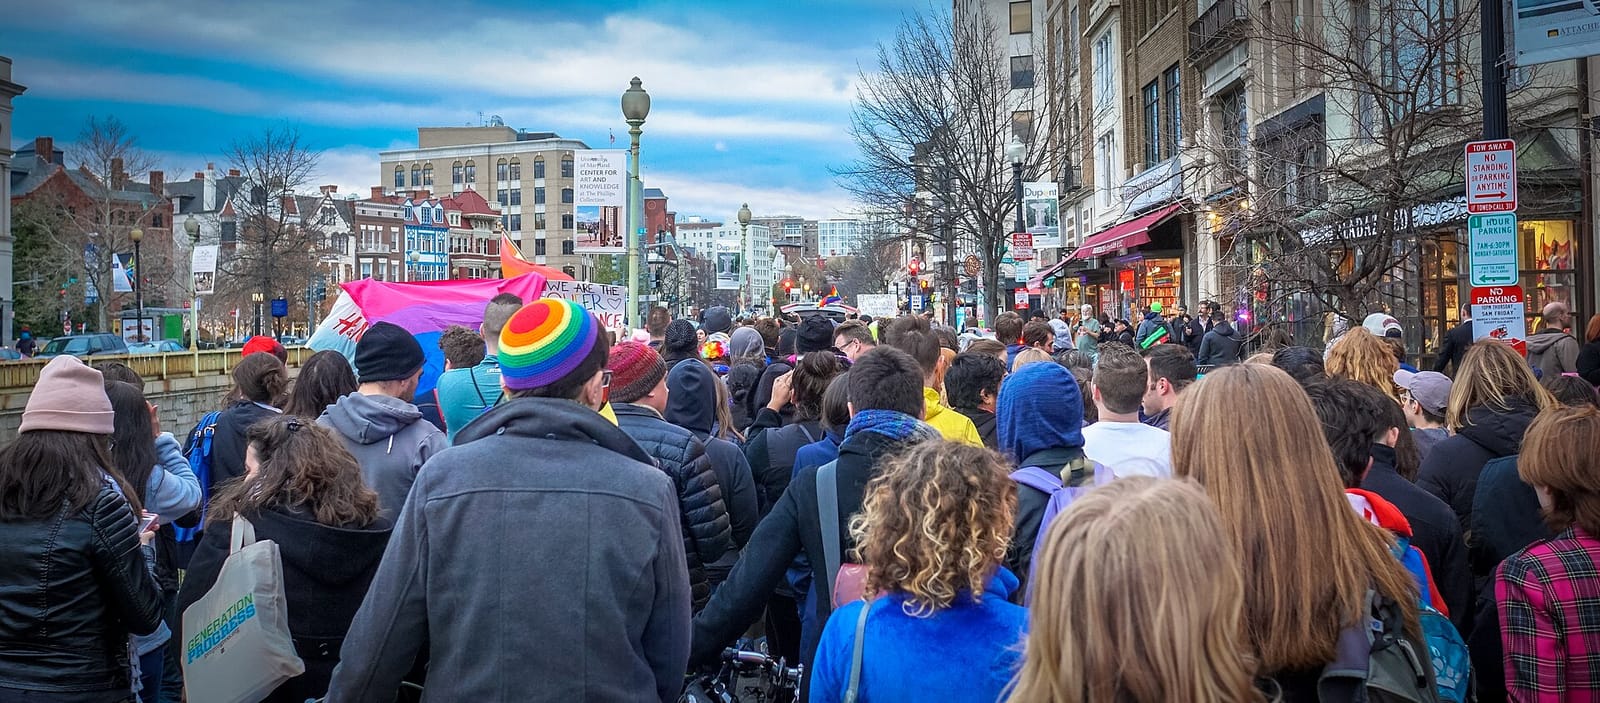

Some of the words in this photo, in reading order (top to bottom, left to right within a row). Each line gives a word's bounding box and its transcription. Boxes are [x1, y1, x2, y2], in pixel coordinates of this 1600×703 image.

[1488, 143, 1507, 151] AWAY
[1485, 154, 1496, 162] NO
[1473, 163, 1508, 173] STANDING
[1479, 172, 1511, 182] PARKING
[1476, 182, 1508, 191] ANYTIME
[1486, 218, 1510, 227] HOUR
[1479, 226, 1512, 236] PARKING
[546, 280, 569, 292] WE
[573, 282, 595, 293] ARE
[600, 284, 620, 296] THE
[1490, 288, 1503, 296] NO
[1477, 295, 1518, 304] PARKING
[187, 592, 255, 650] GENERATION
[187, 603, 256, 665] PROGRESS
